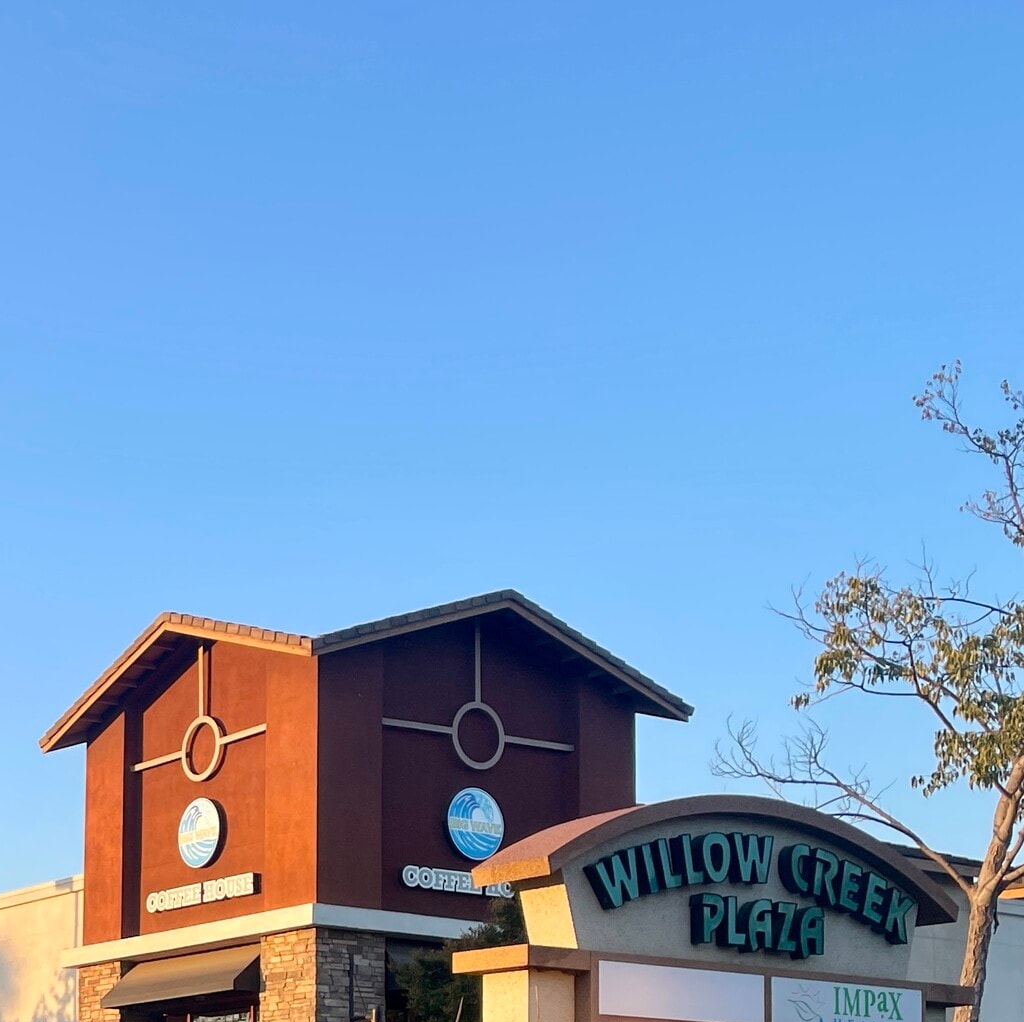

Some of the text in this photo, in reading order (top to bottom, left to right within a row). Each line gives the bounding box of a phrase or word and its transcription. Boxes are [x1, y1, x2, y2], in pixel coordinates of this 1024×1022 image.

[146, 872, 255, 913] COFFEE HOUSE
[584, 831, 918, 945] WILLOW CREEK
[689, 893, 825, 959] PLAZA
